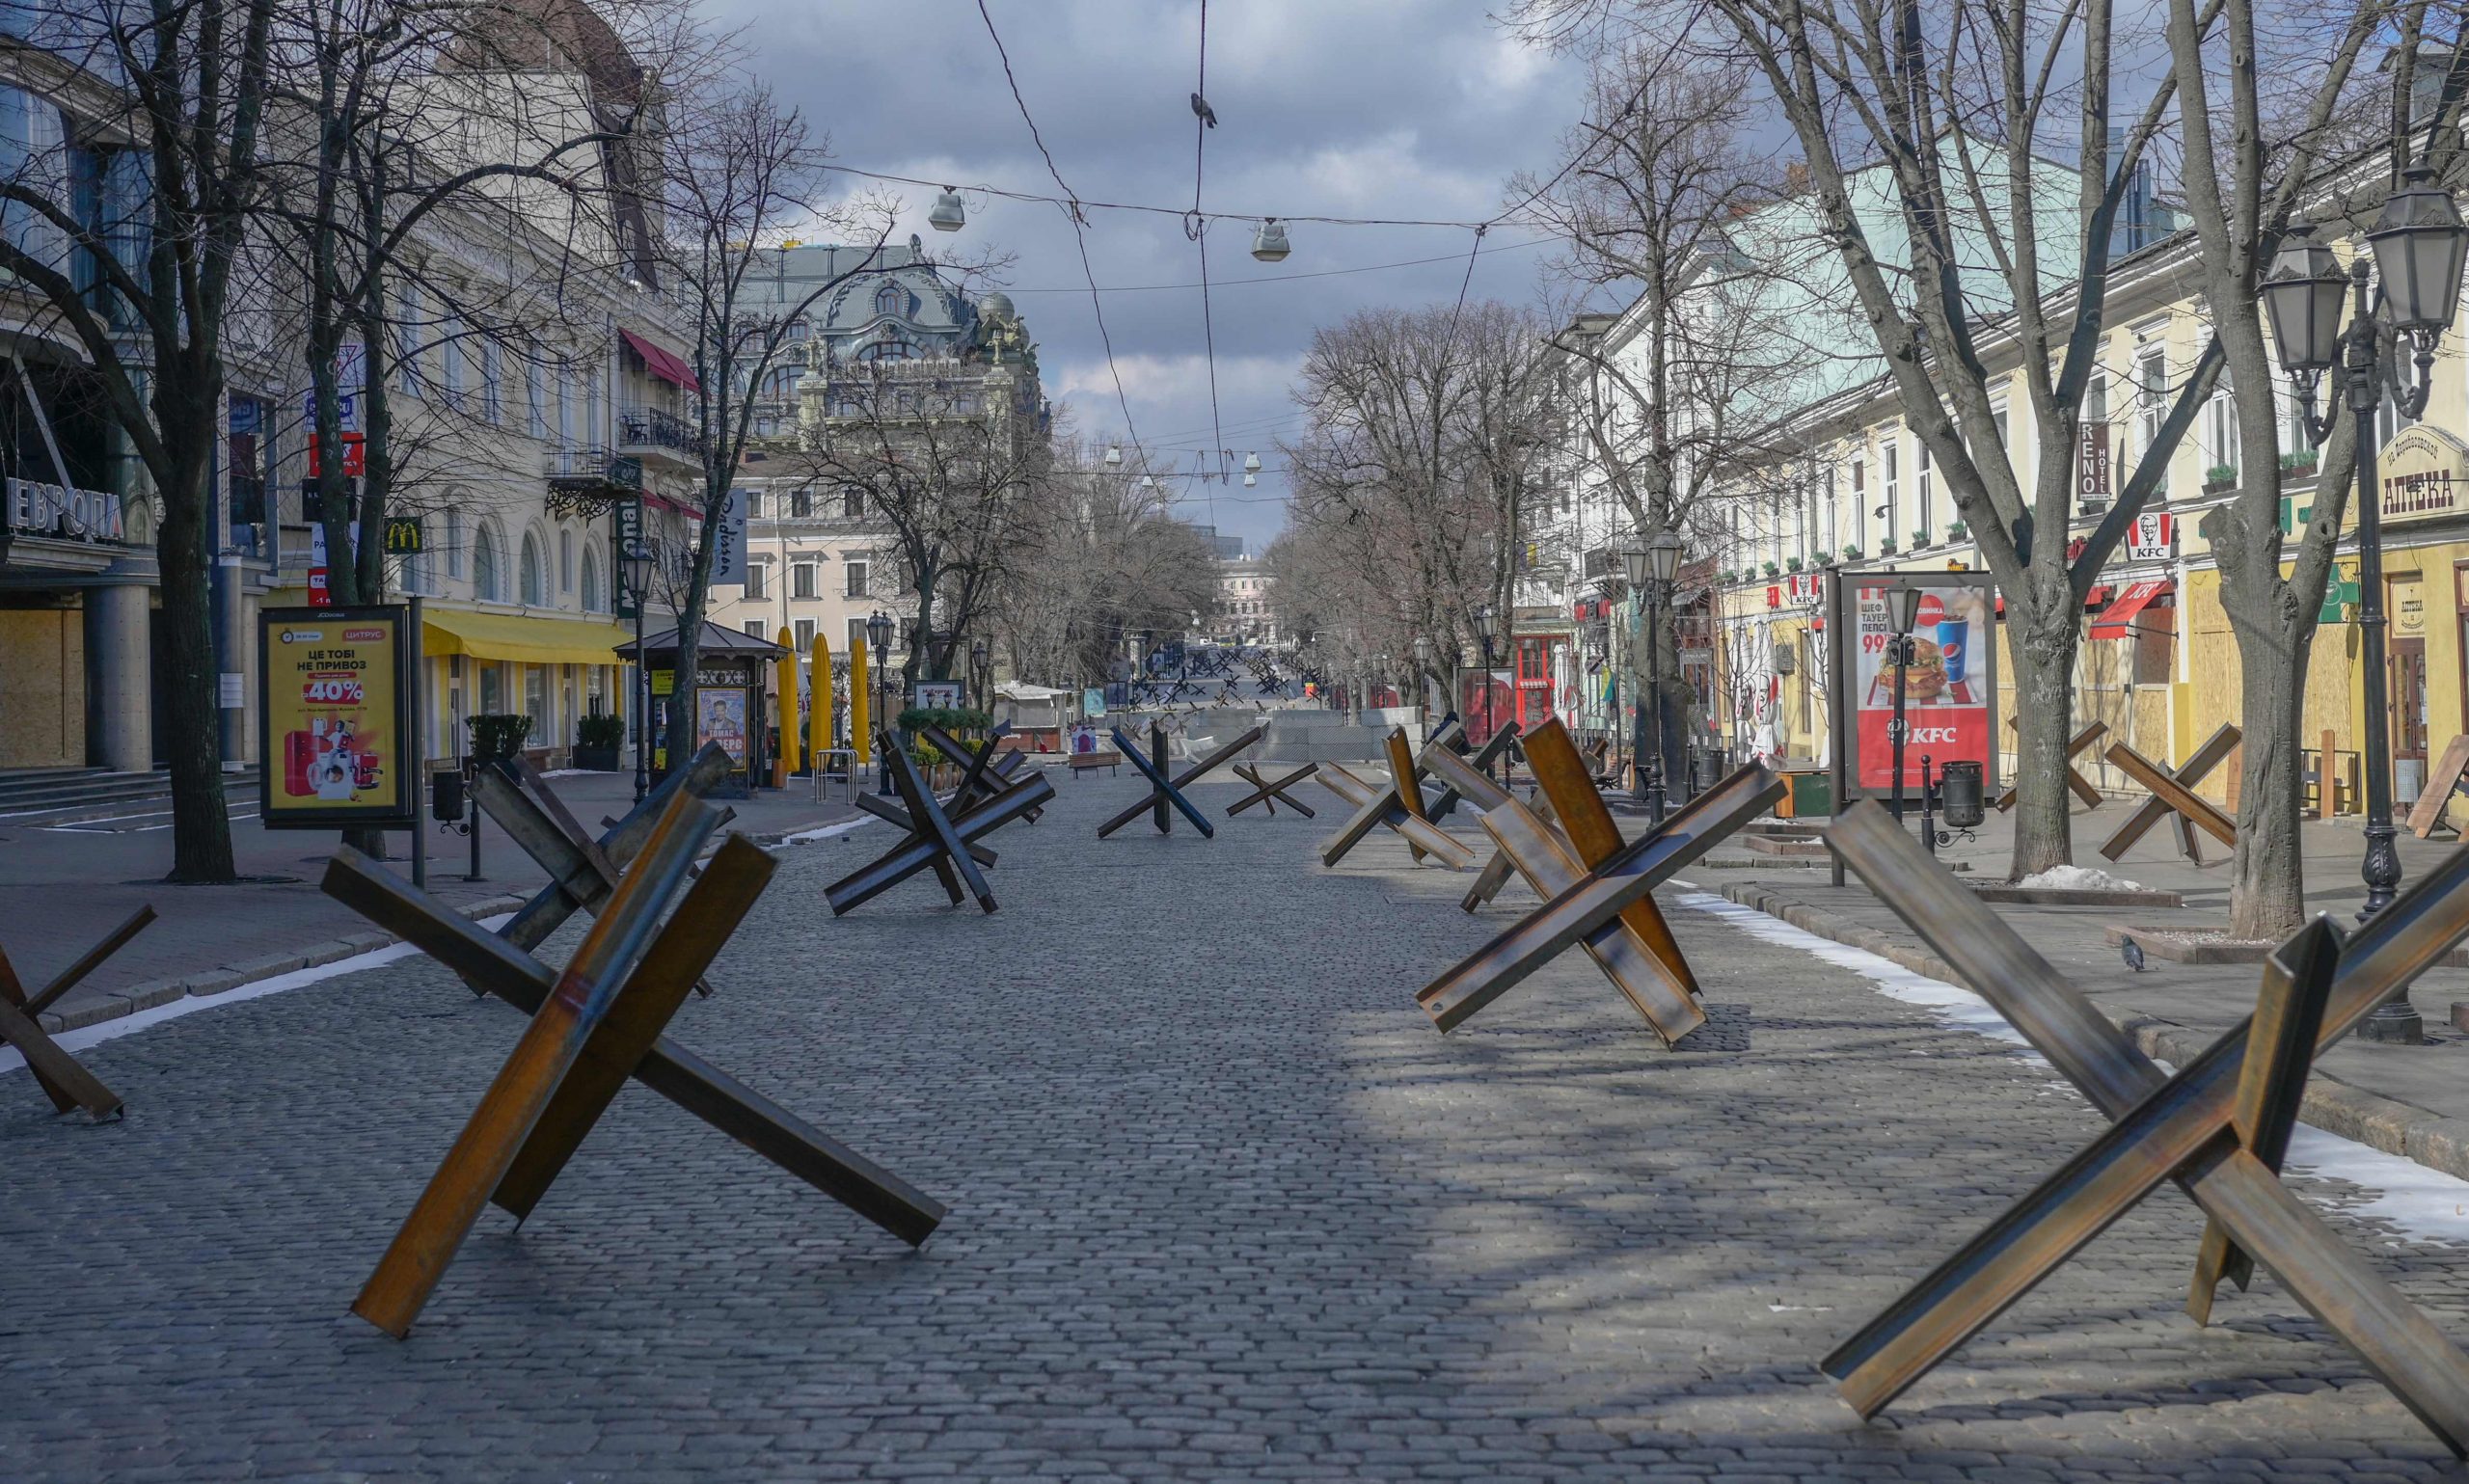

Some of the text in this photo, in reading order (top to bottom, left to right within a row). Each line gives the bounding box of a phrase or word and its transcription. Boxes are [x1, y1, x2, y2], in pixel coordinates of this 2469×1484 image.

[2082, 423, 2095, 494] RENO
[2383, 469, 2455, 515] АПТЕКА
[8, 476, 124, 538] ЕВРОПА
[2136, 547, 2164, 558] KFC
[2128, 581, 2159, 600] KFC
[1861, 604, 1883, 613] ШЕФ
[1916, 607, 1943, 615] ОВИНКА
[1861, 613, 1887, 623] ТАУЕР
[1861, 623, 1887, 633] ПЕПСІ
[1862, 634, 1884, 654] 99
[308, 650, 355, 661] ЦЕ ТОБІ
[297, 661, 366, 671] НЕ ПРИВОЗ
[709, 729, 734, 738] ТОМАС
[1912, 727, 1957, 743] KFC
